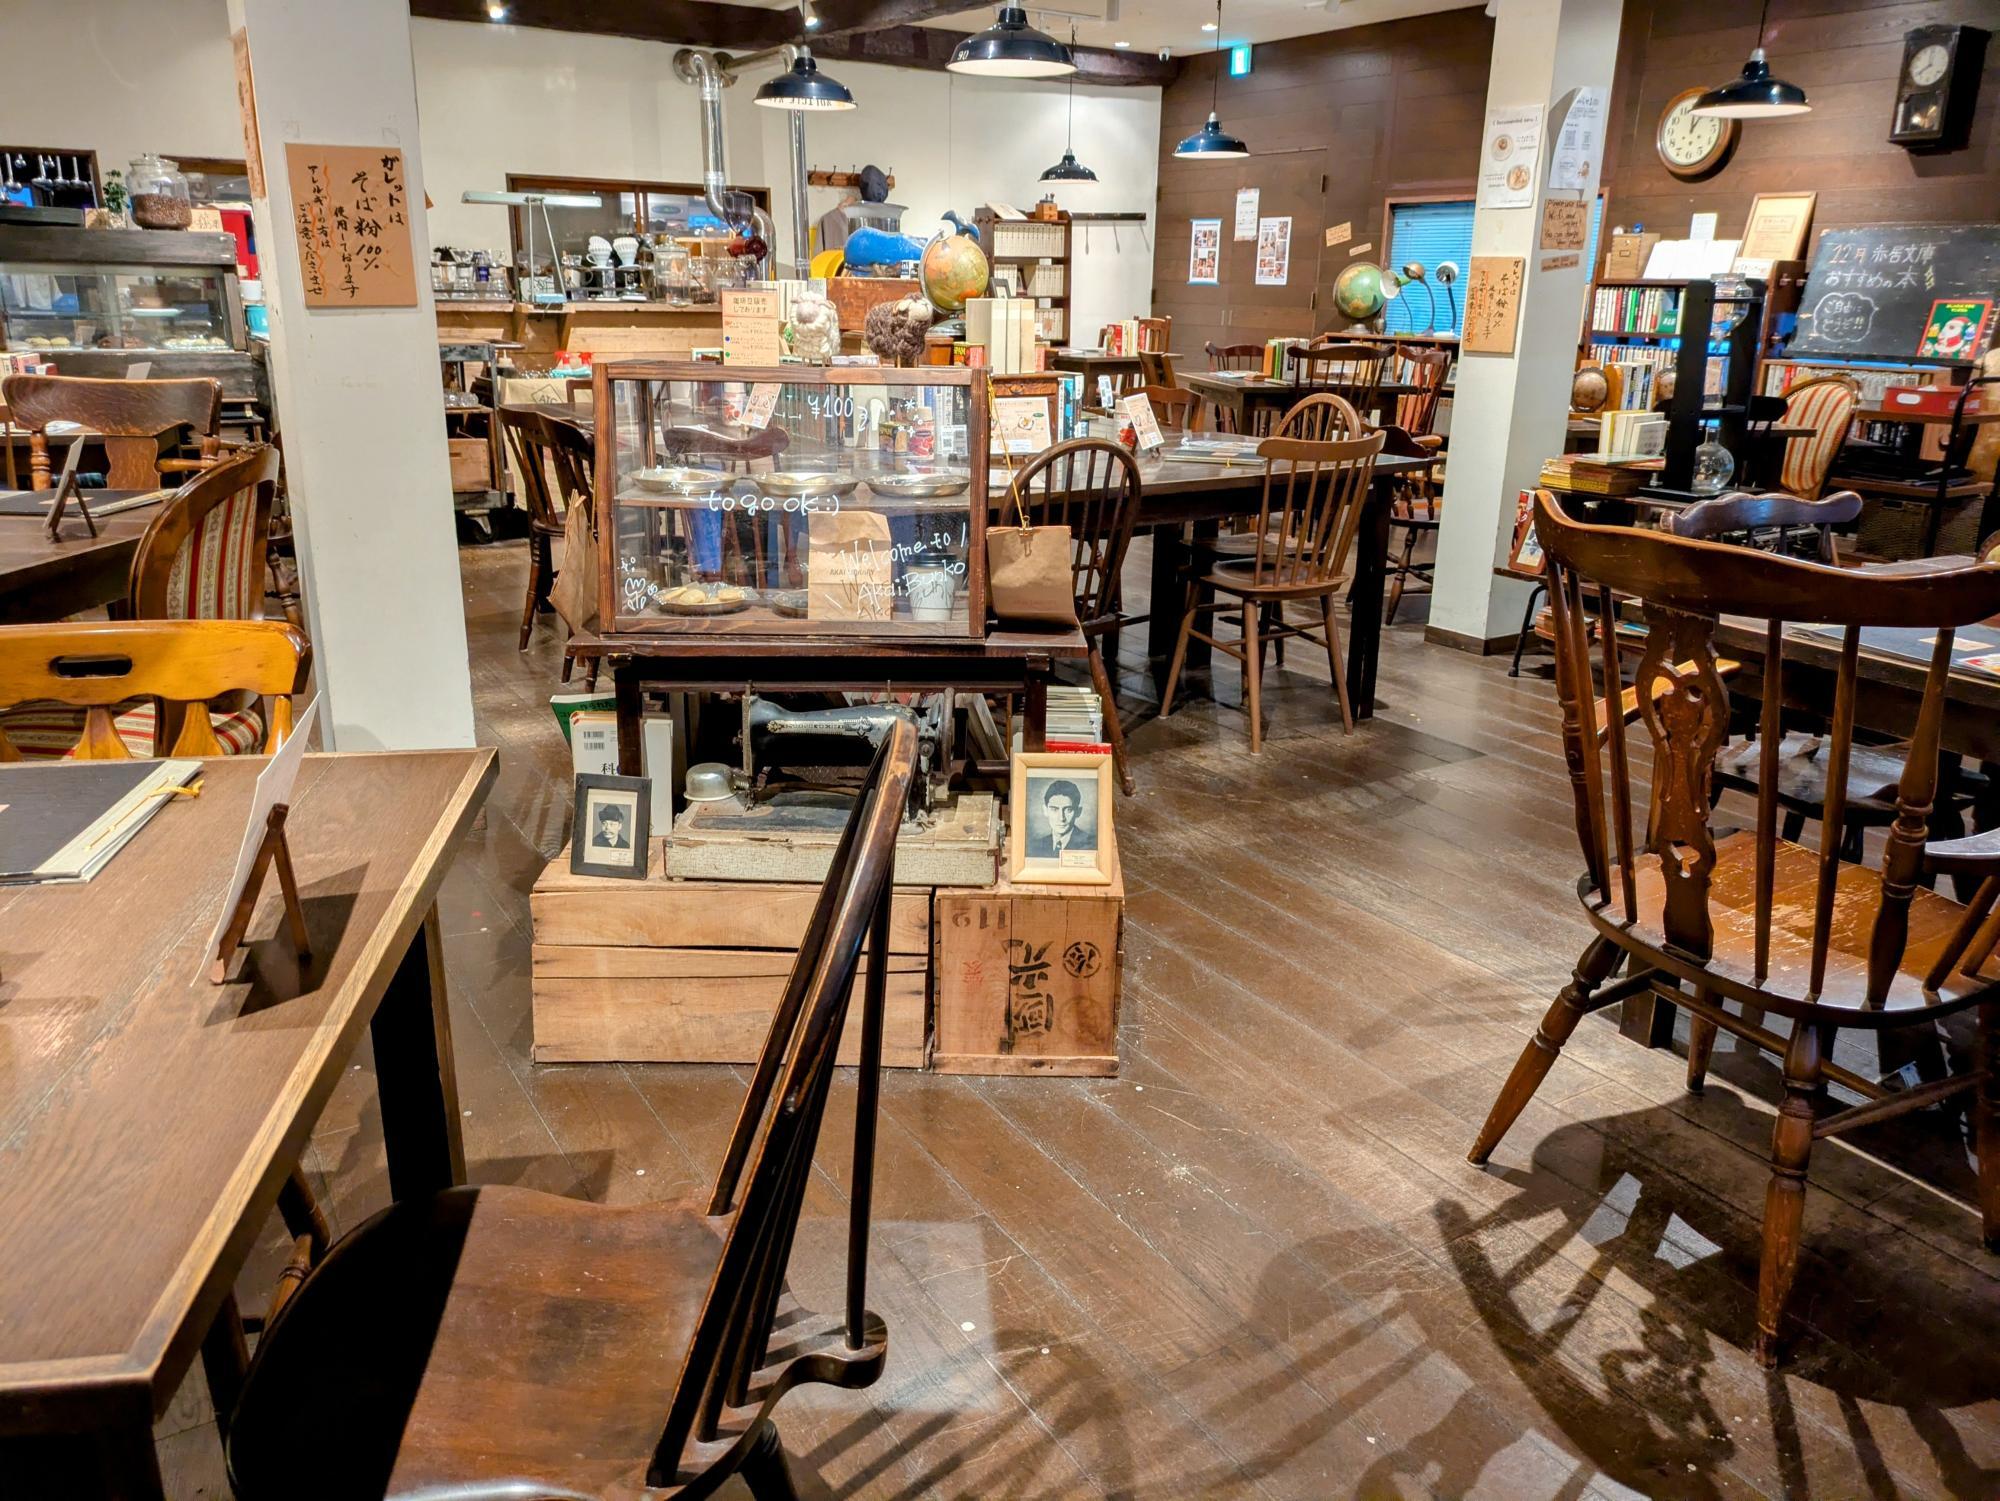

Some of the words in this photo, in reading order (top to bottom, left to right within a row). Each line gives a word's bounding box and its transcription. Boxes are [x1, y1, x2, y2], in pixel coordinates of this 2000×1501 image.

[308, 165, 331, 248] アレルギーの方は
[381, 155, 404, 225] ガレットは
[334, 206, 360, 298] 使用しております
[699, 489, 735, 511] to
[740, 494, 776, 516] go
[840, 539, 927, 576] Welcome
[930, 532, 951, 549] to
